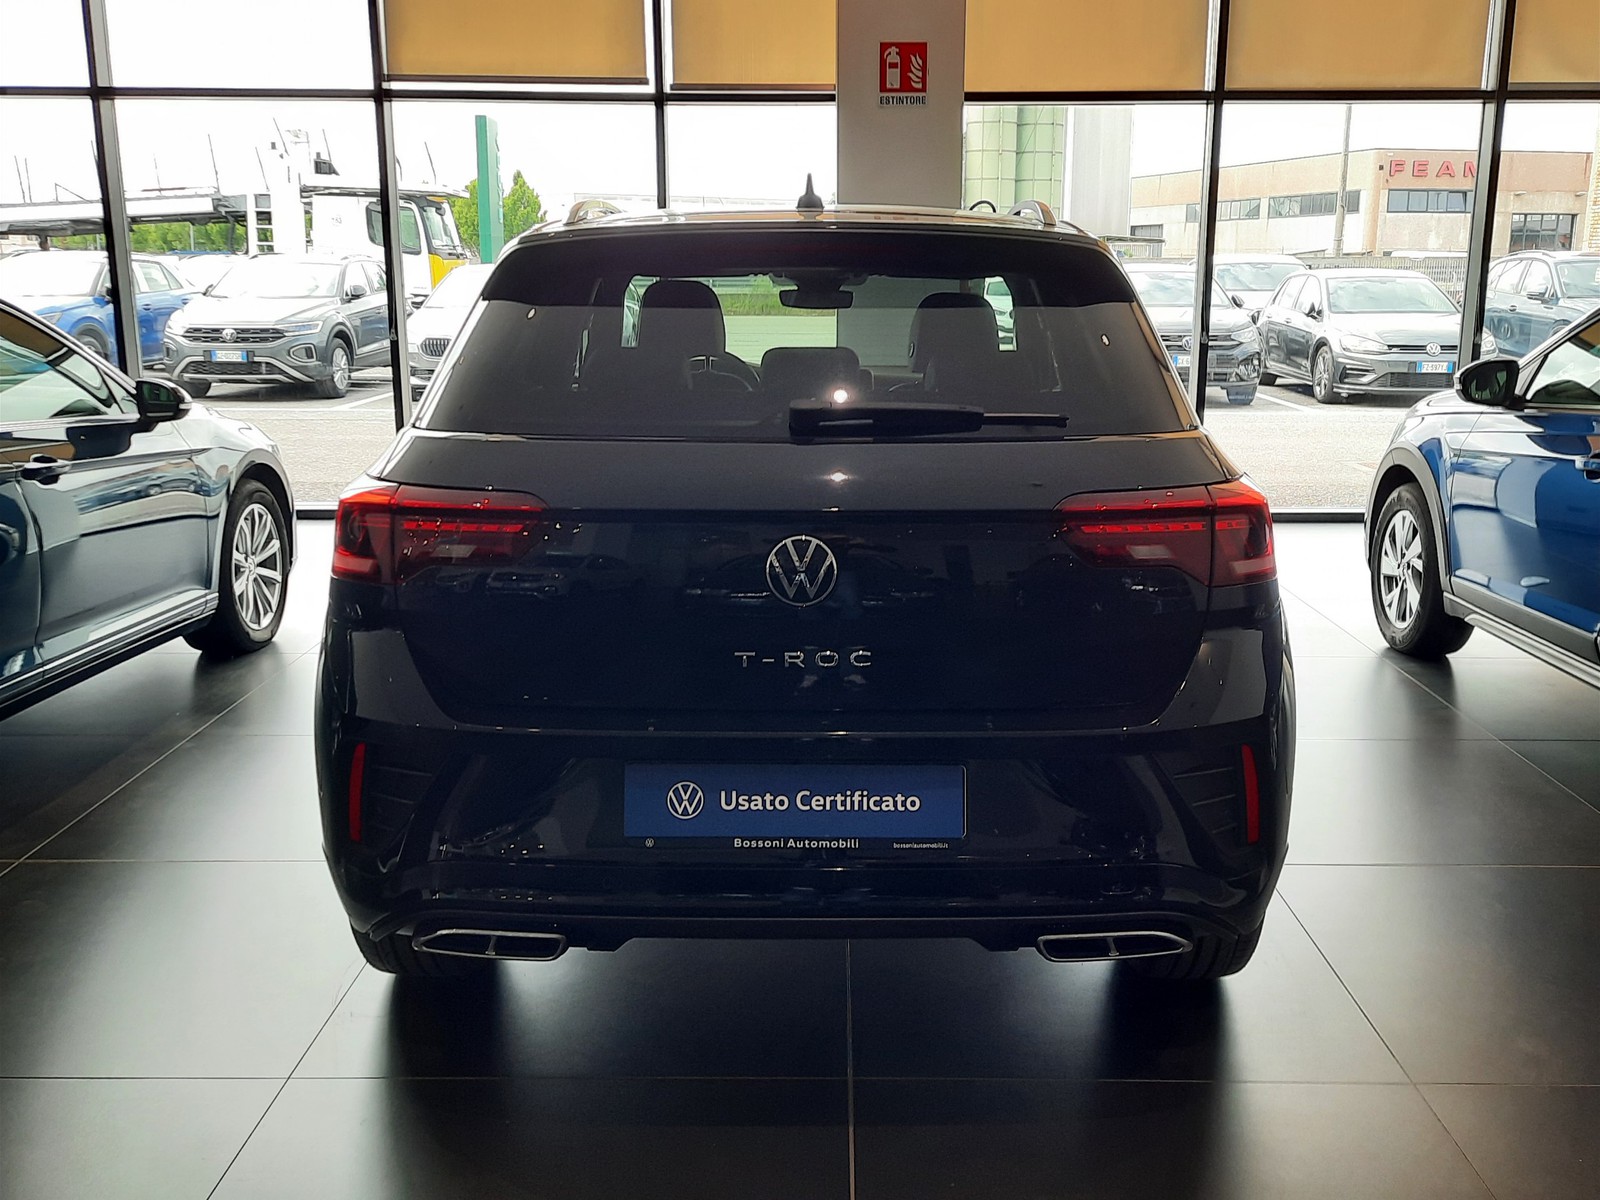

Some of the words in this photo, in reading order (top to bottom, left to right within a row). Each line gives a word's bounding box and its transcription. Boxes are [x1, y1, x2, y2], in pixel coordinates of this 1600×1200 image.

[879, 95, 927, 106] ESTINTORE
[734, 650, 872, 668] T-ROC
[720, 790, 789, 811] Usato
[796, 790, 922, 812] Certificato
[733, 838, 784, 848] Bossoni
[787, 838, 860, 849] Automobili
